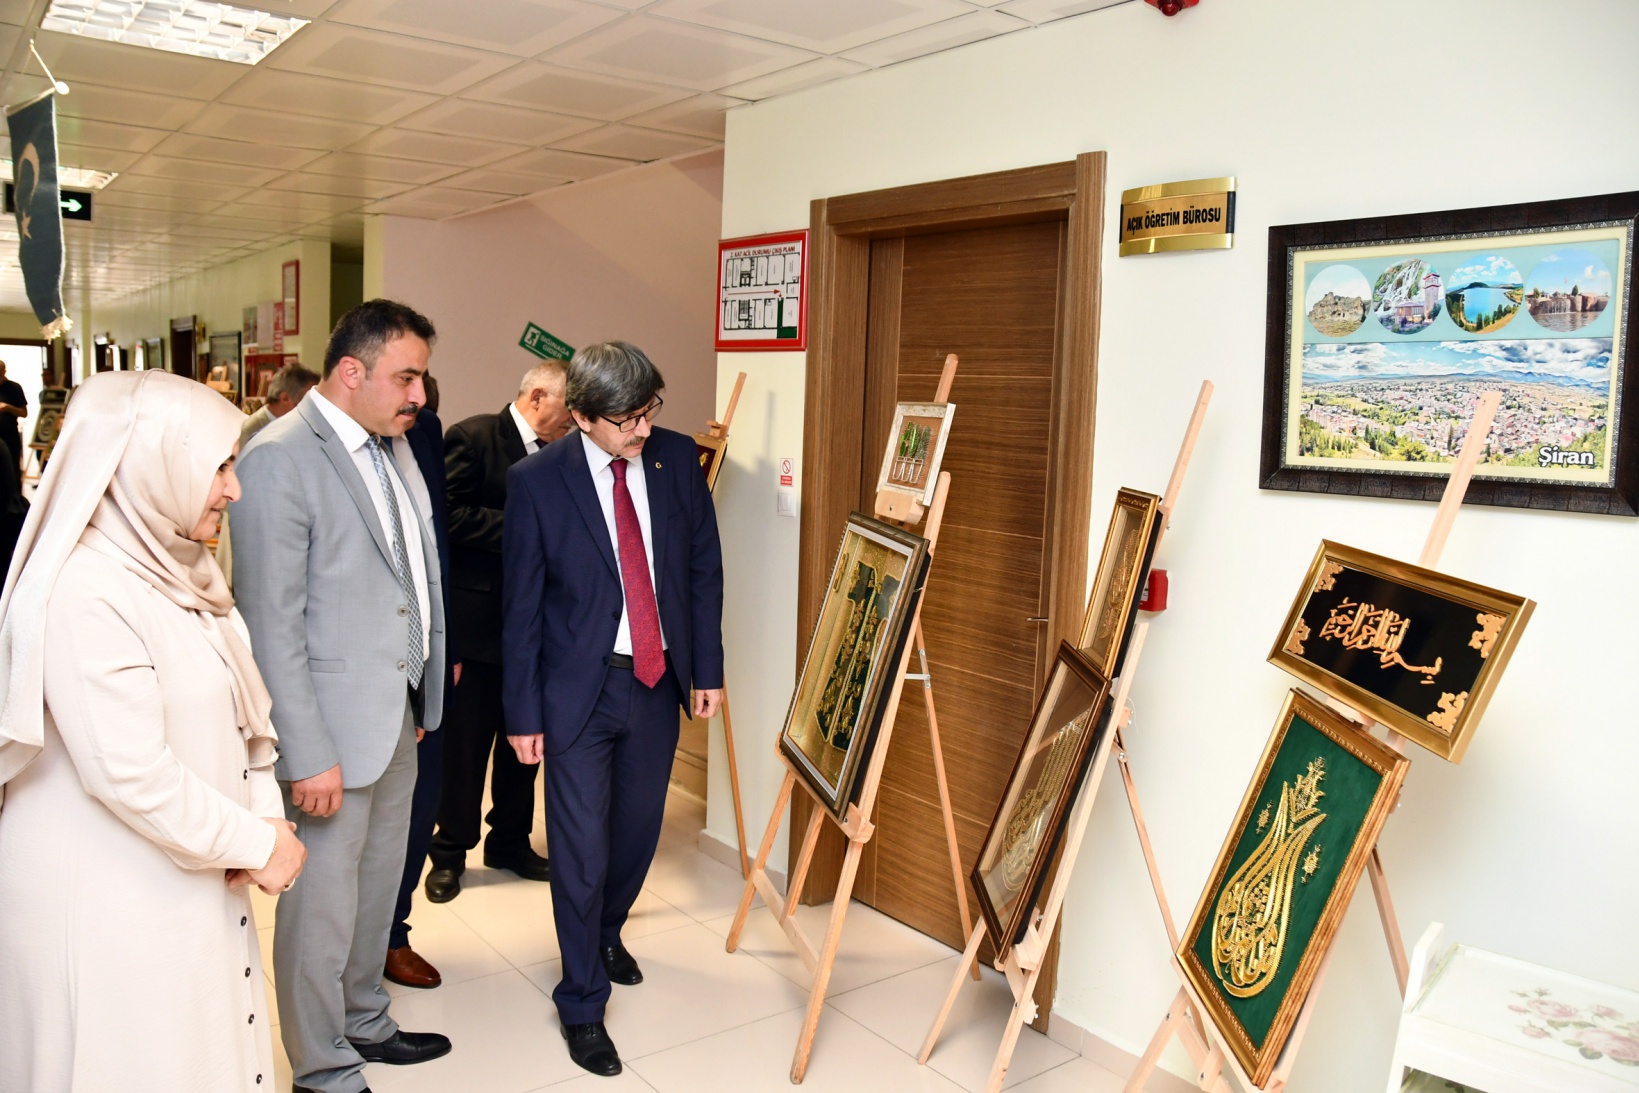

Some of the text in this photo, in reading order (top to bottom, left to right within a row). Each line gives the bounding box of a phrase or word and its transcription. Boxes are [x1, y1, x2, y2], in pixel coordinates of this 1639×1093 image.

[1127, 206, 1221, 235] AÇIK ÖĞRETİM BÜROSU
[1538, 445, 1594, 467] Şiran
